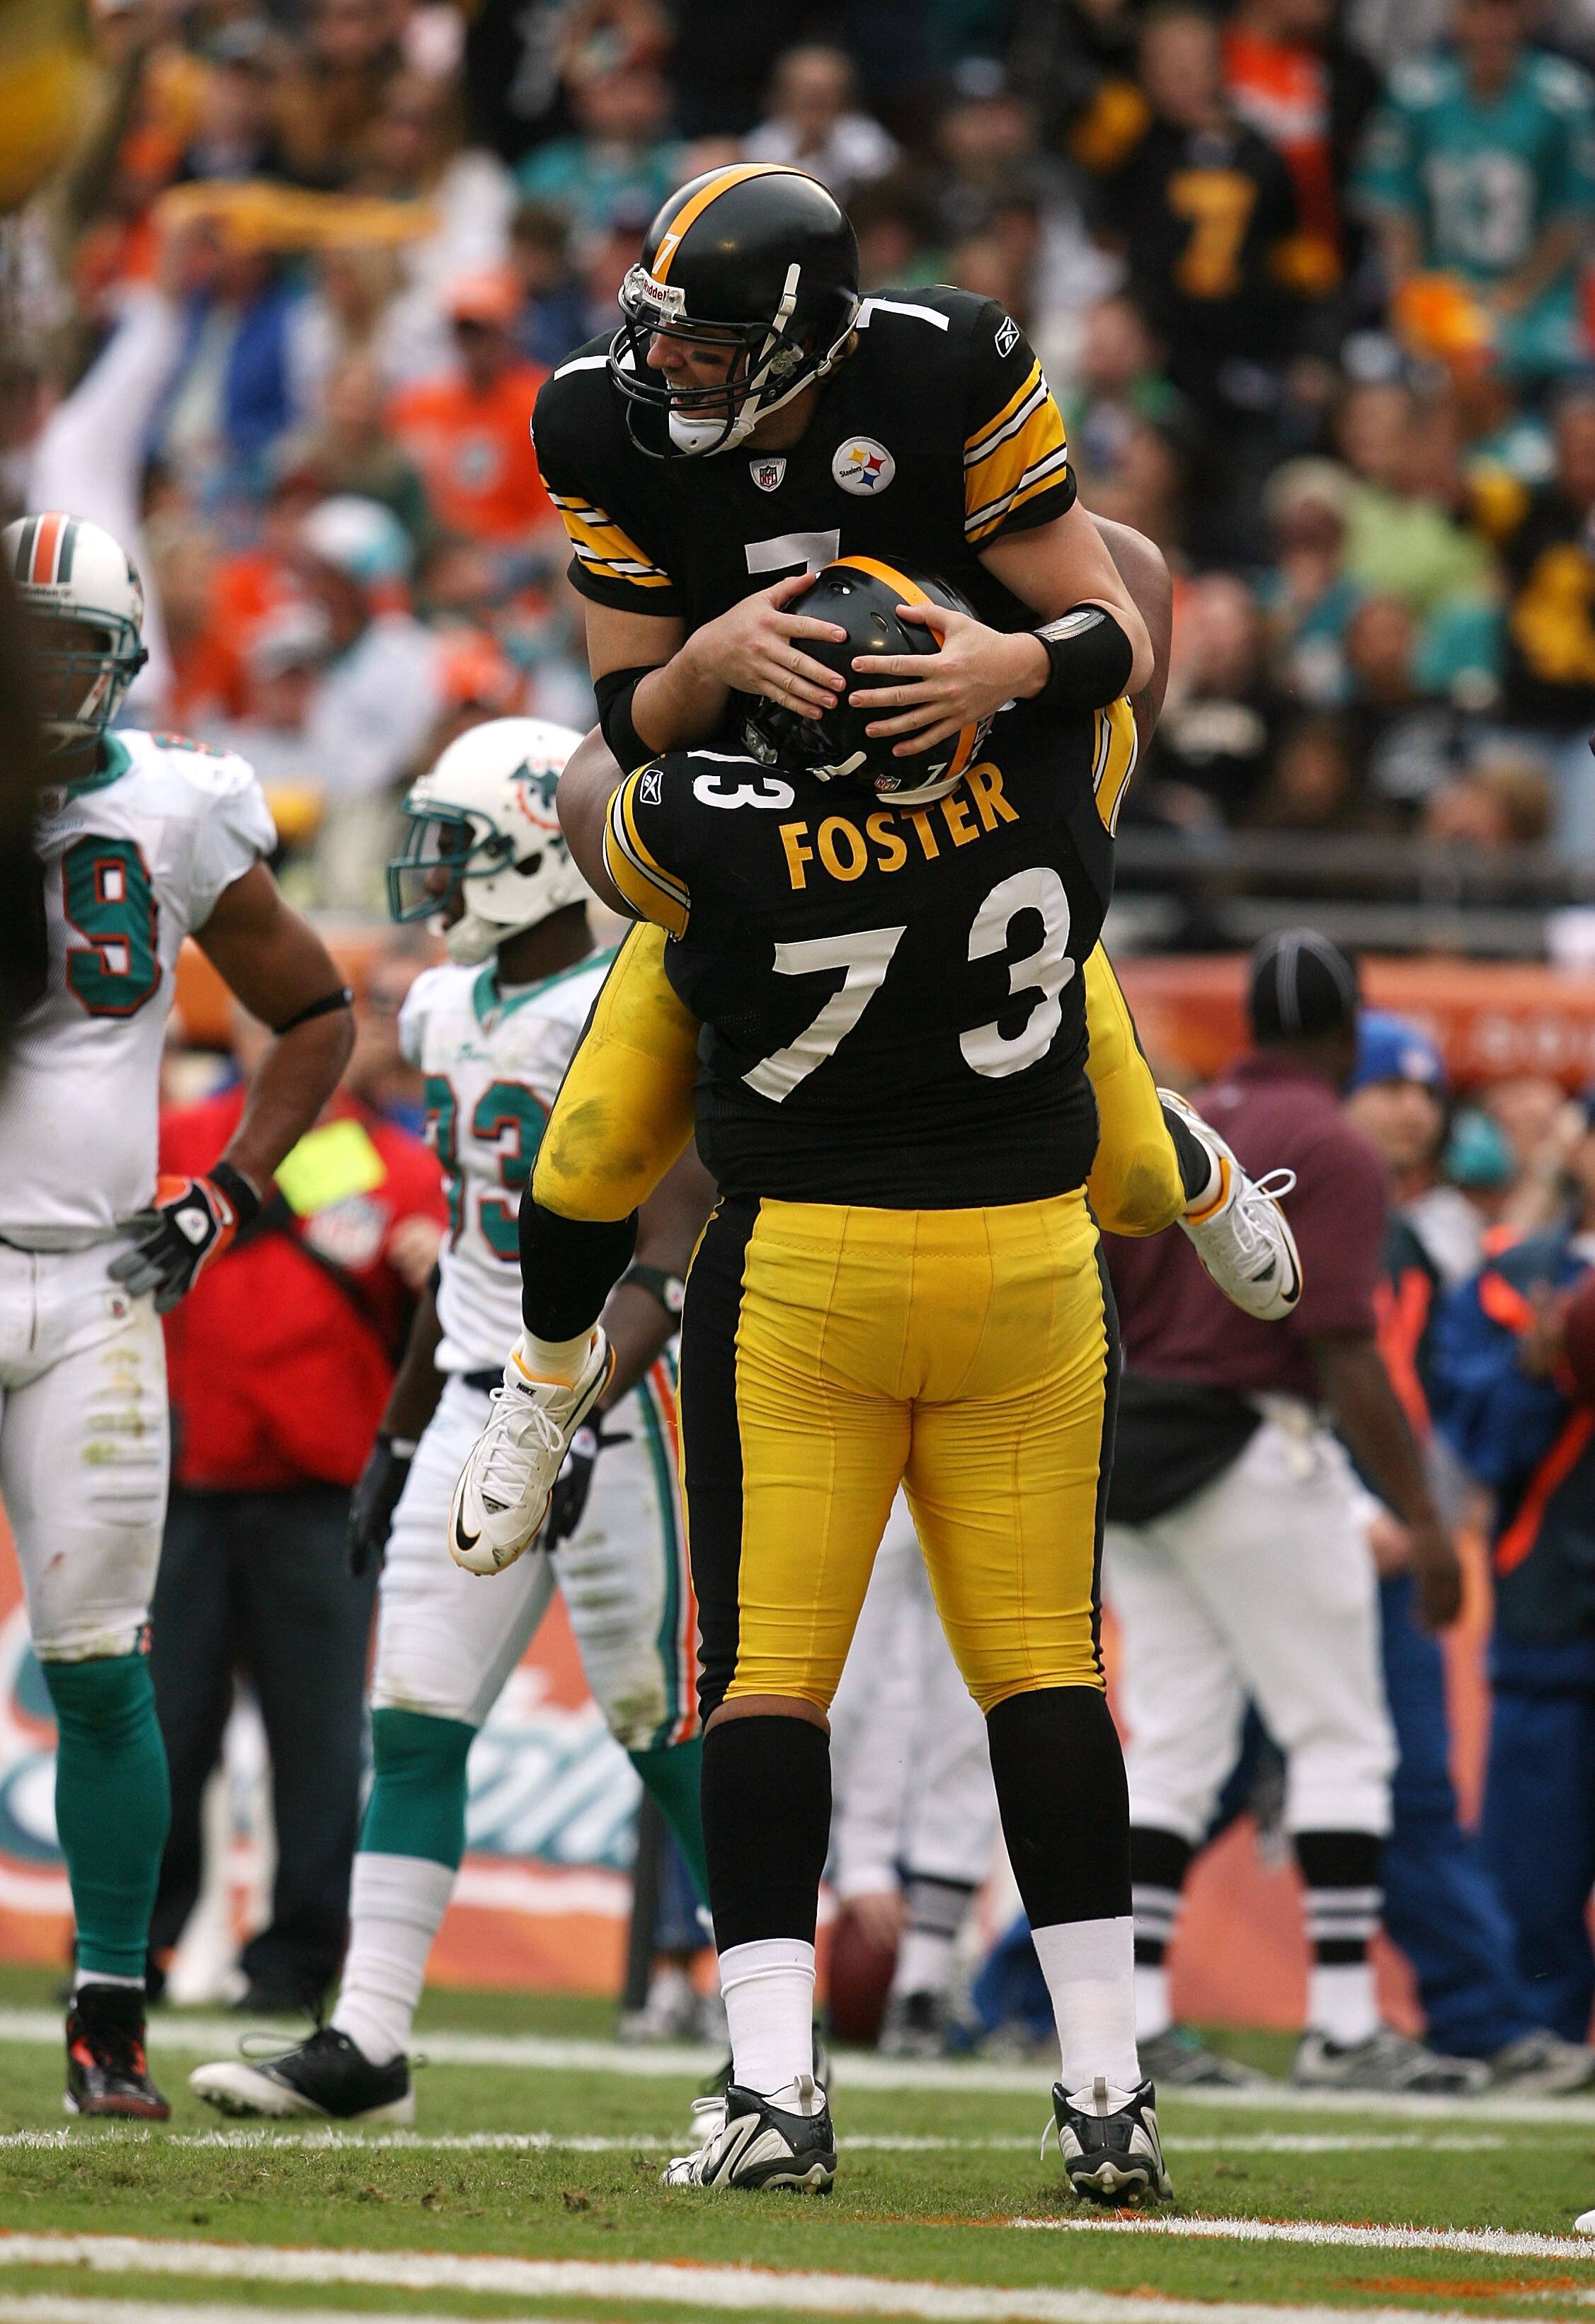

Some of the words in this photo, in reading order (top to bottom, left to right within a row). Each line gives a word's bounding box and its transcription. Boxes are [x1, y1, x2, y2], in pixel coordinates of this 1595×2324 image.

[651, 232, 681, 275] 7
[1165, 169, 1257, 299] 7
[761, 474, 777, 486] NFL
[839, 465, 863, 478] Steelers
[915, 762, 947, 791] 7
[778, 762, 1020, 890] FOSTER
[61, 833, 163, 1018] 9
[741, 867, 1076, 1104] 73
[515, 1382, 537, 1399] NIKE
